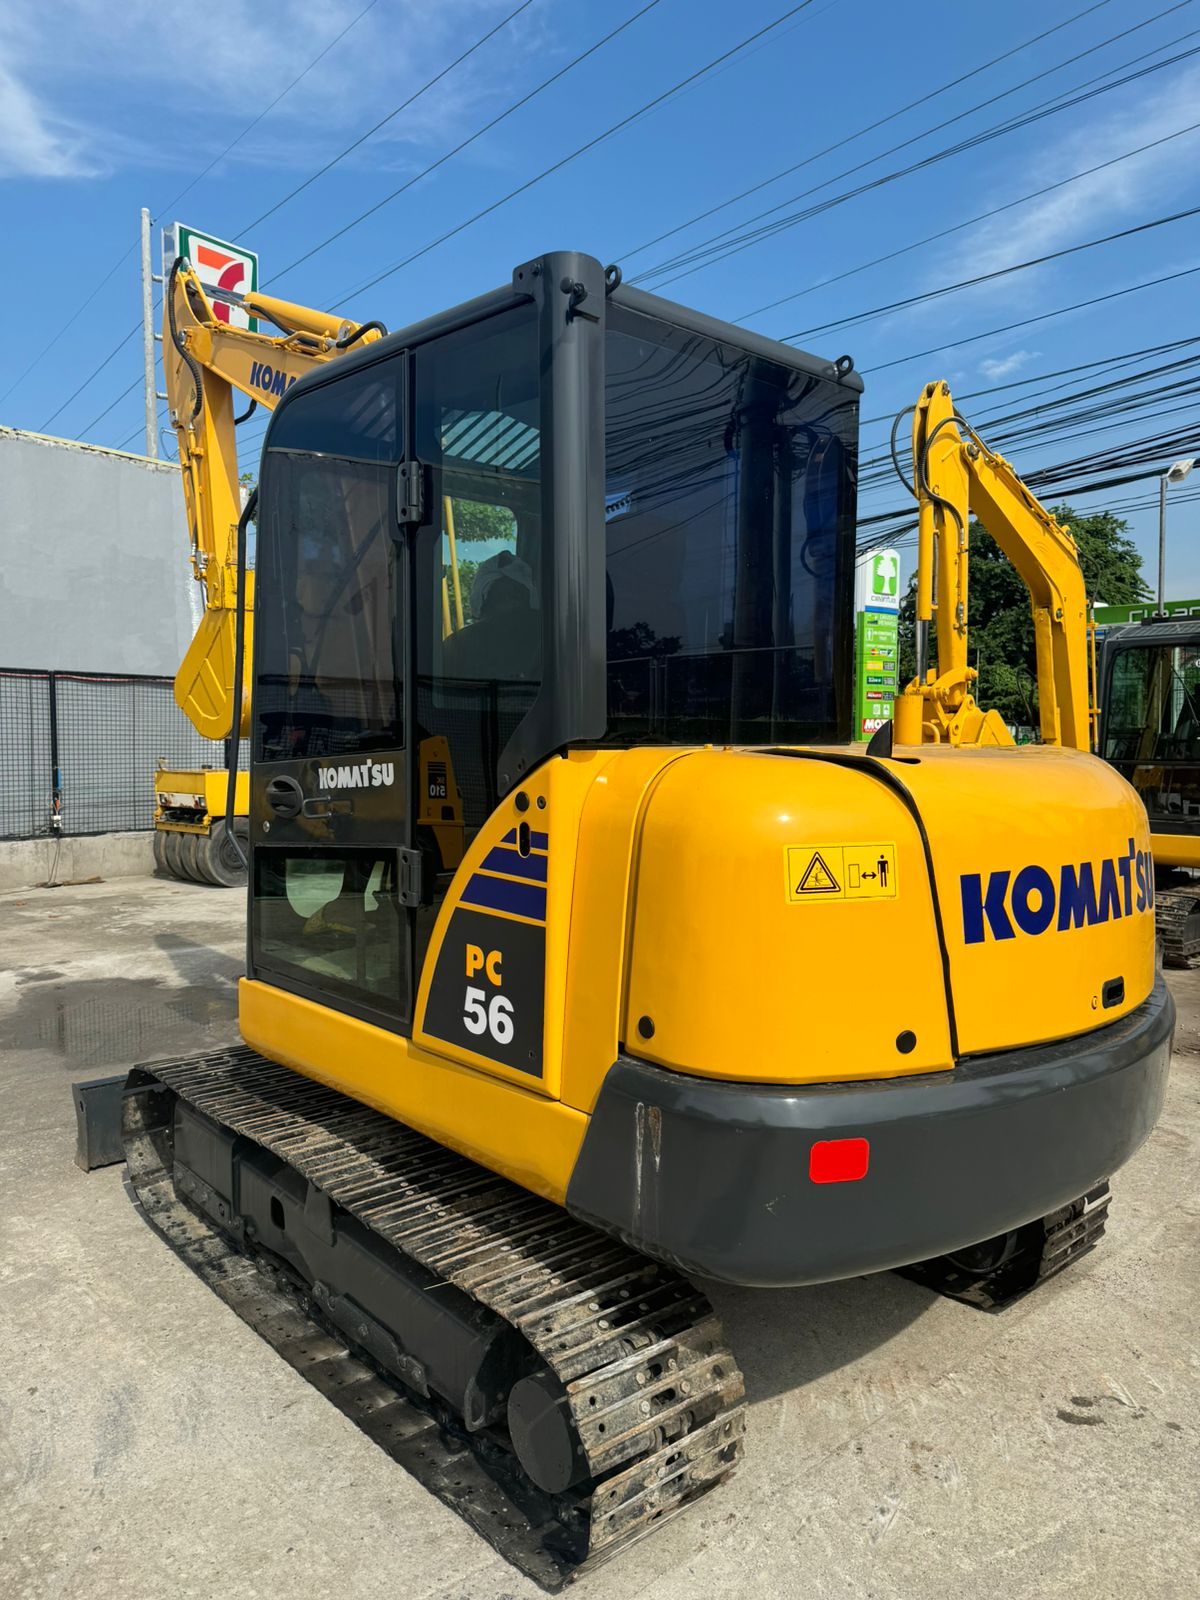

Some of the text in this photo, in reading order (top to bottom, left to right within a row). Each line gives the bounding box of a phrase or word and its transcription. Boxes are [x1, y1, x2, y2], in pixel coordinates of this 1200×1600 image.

[318, 758, 394, 789] KOMATSU
[960, 837, 1154, 944] KOMATSU
[465, 943, 503, 987] PC
[463, 985, 515, 1045] 56
